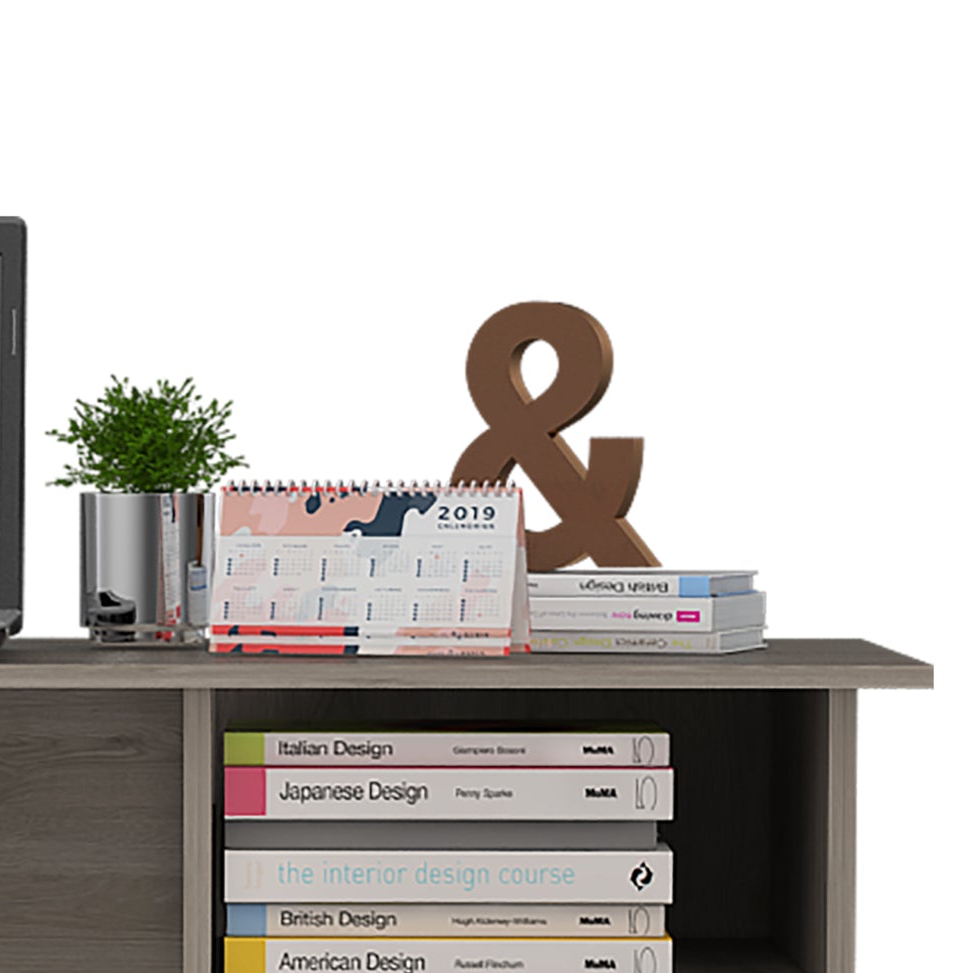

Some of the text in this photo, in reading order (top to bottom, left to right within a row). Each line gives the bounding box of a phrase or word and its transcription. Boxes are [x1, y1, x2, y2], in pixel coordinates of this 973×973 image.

[438, 506, 495, 520] 2019
[579, 580, 624, 593] Design
[278, 740, 393, 760] Italian Design
[279, 781, 428, 804] Japanese Design
[278, 861, 576, 891] the interior design course
[280, 910, 397, 930] British Design
[278, 953, 361, 971] American
